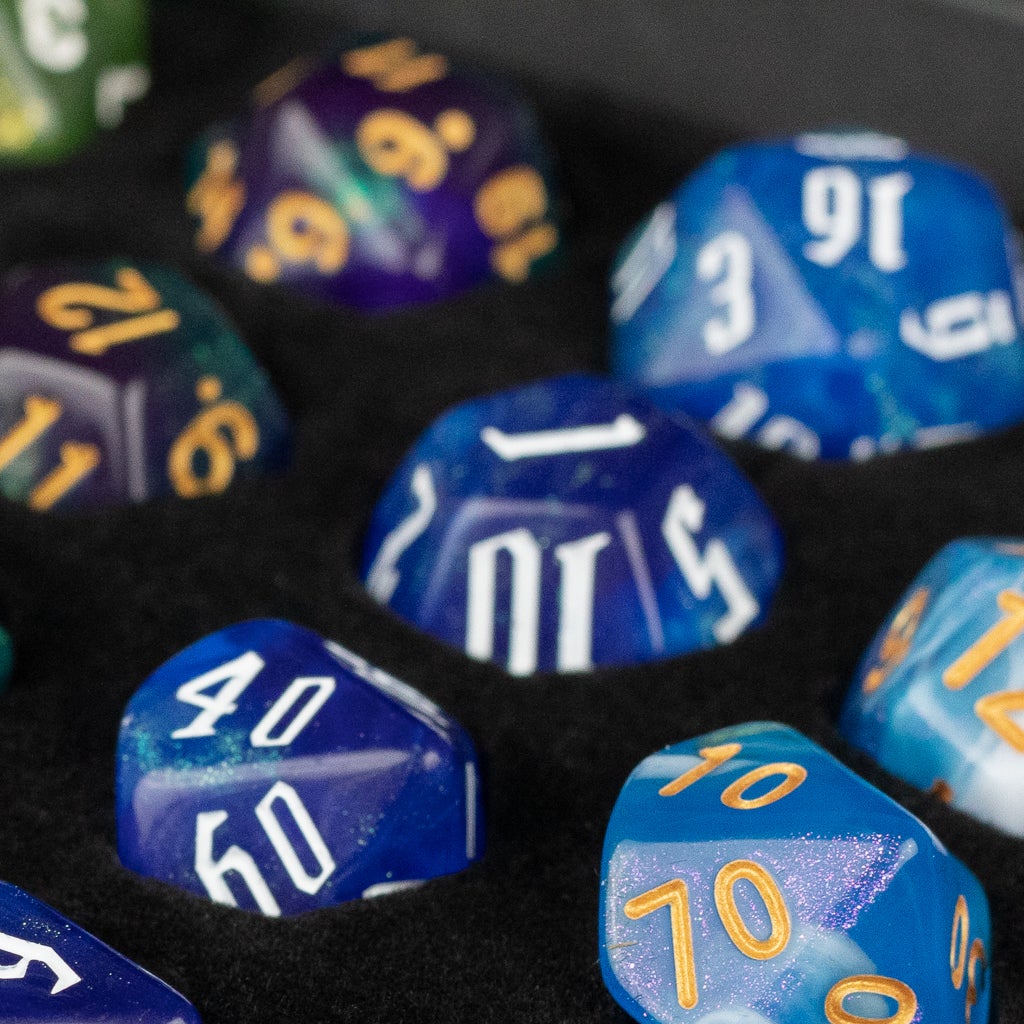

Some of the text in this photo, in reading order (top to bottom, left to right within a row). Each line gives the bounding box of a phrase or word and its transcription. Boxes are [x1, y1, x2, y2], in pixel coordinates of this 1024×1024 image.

[34, 266, 180, 356] 12
[696, 231, 756, 357] 3
[171, 650, 336, 747] 40
[658, 743, 808, 810] 10
[623, 858, 792, 1010] 70
